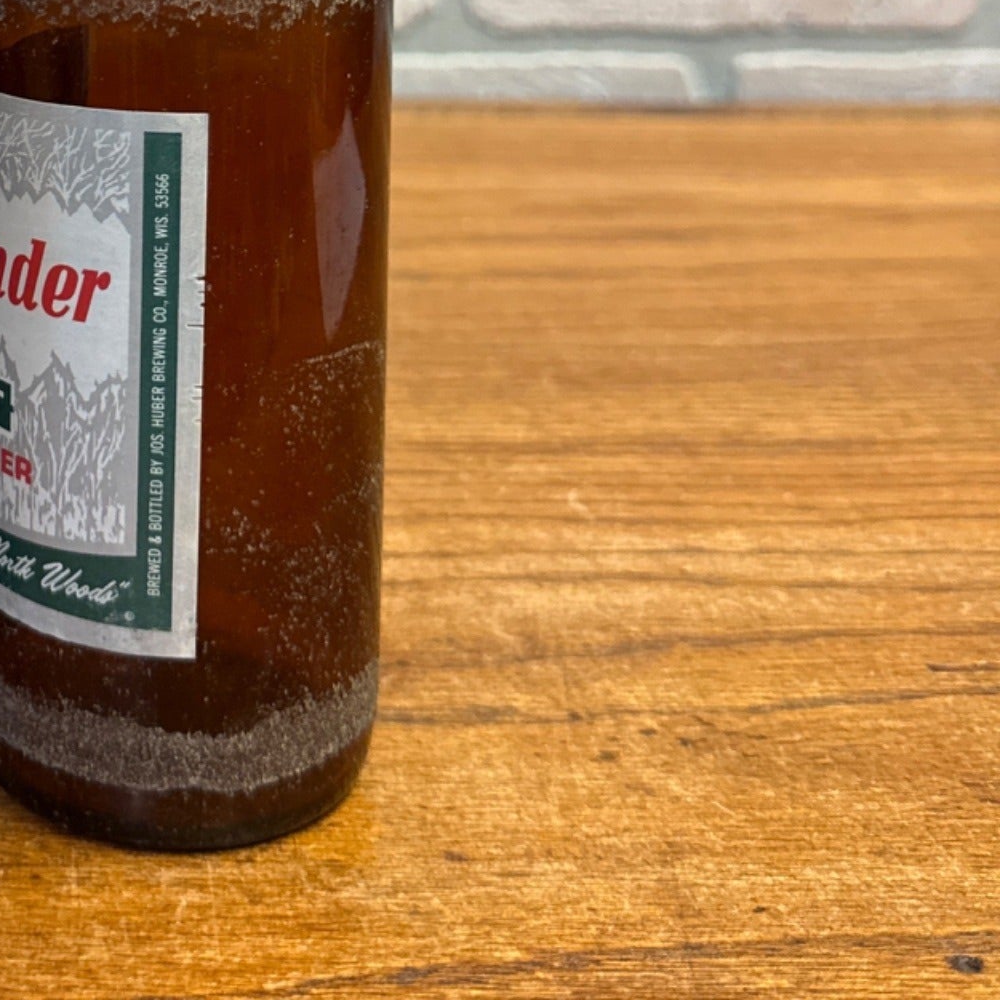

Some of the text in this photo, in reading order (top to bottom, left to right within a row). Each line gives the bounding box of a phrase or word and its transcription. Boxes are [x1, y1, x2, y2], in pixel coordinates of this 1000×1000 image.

[154, 173, 170, 209] 53566
[153, 242, 169, 297] MONROE,
[152, 300, 168, 323] CO.,
[152, 328, 167, 382] BREWING
[151, 386, 165, 428] HUBER
[149, 459, 164, 475] BY
[148, 480, 163, 531] BOTTLED
[148, 535, 162, 544] &
[147, 549, 161, 597] BREWED
